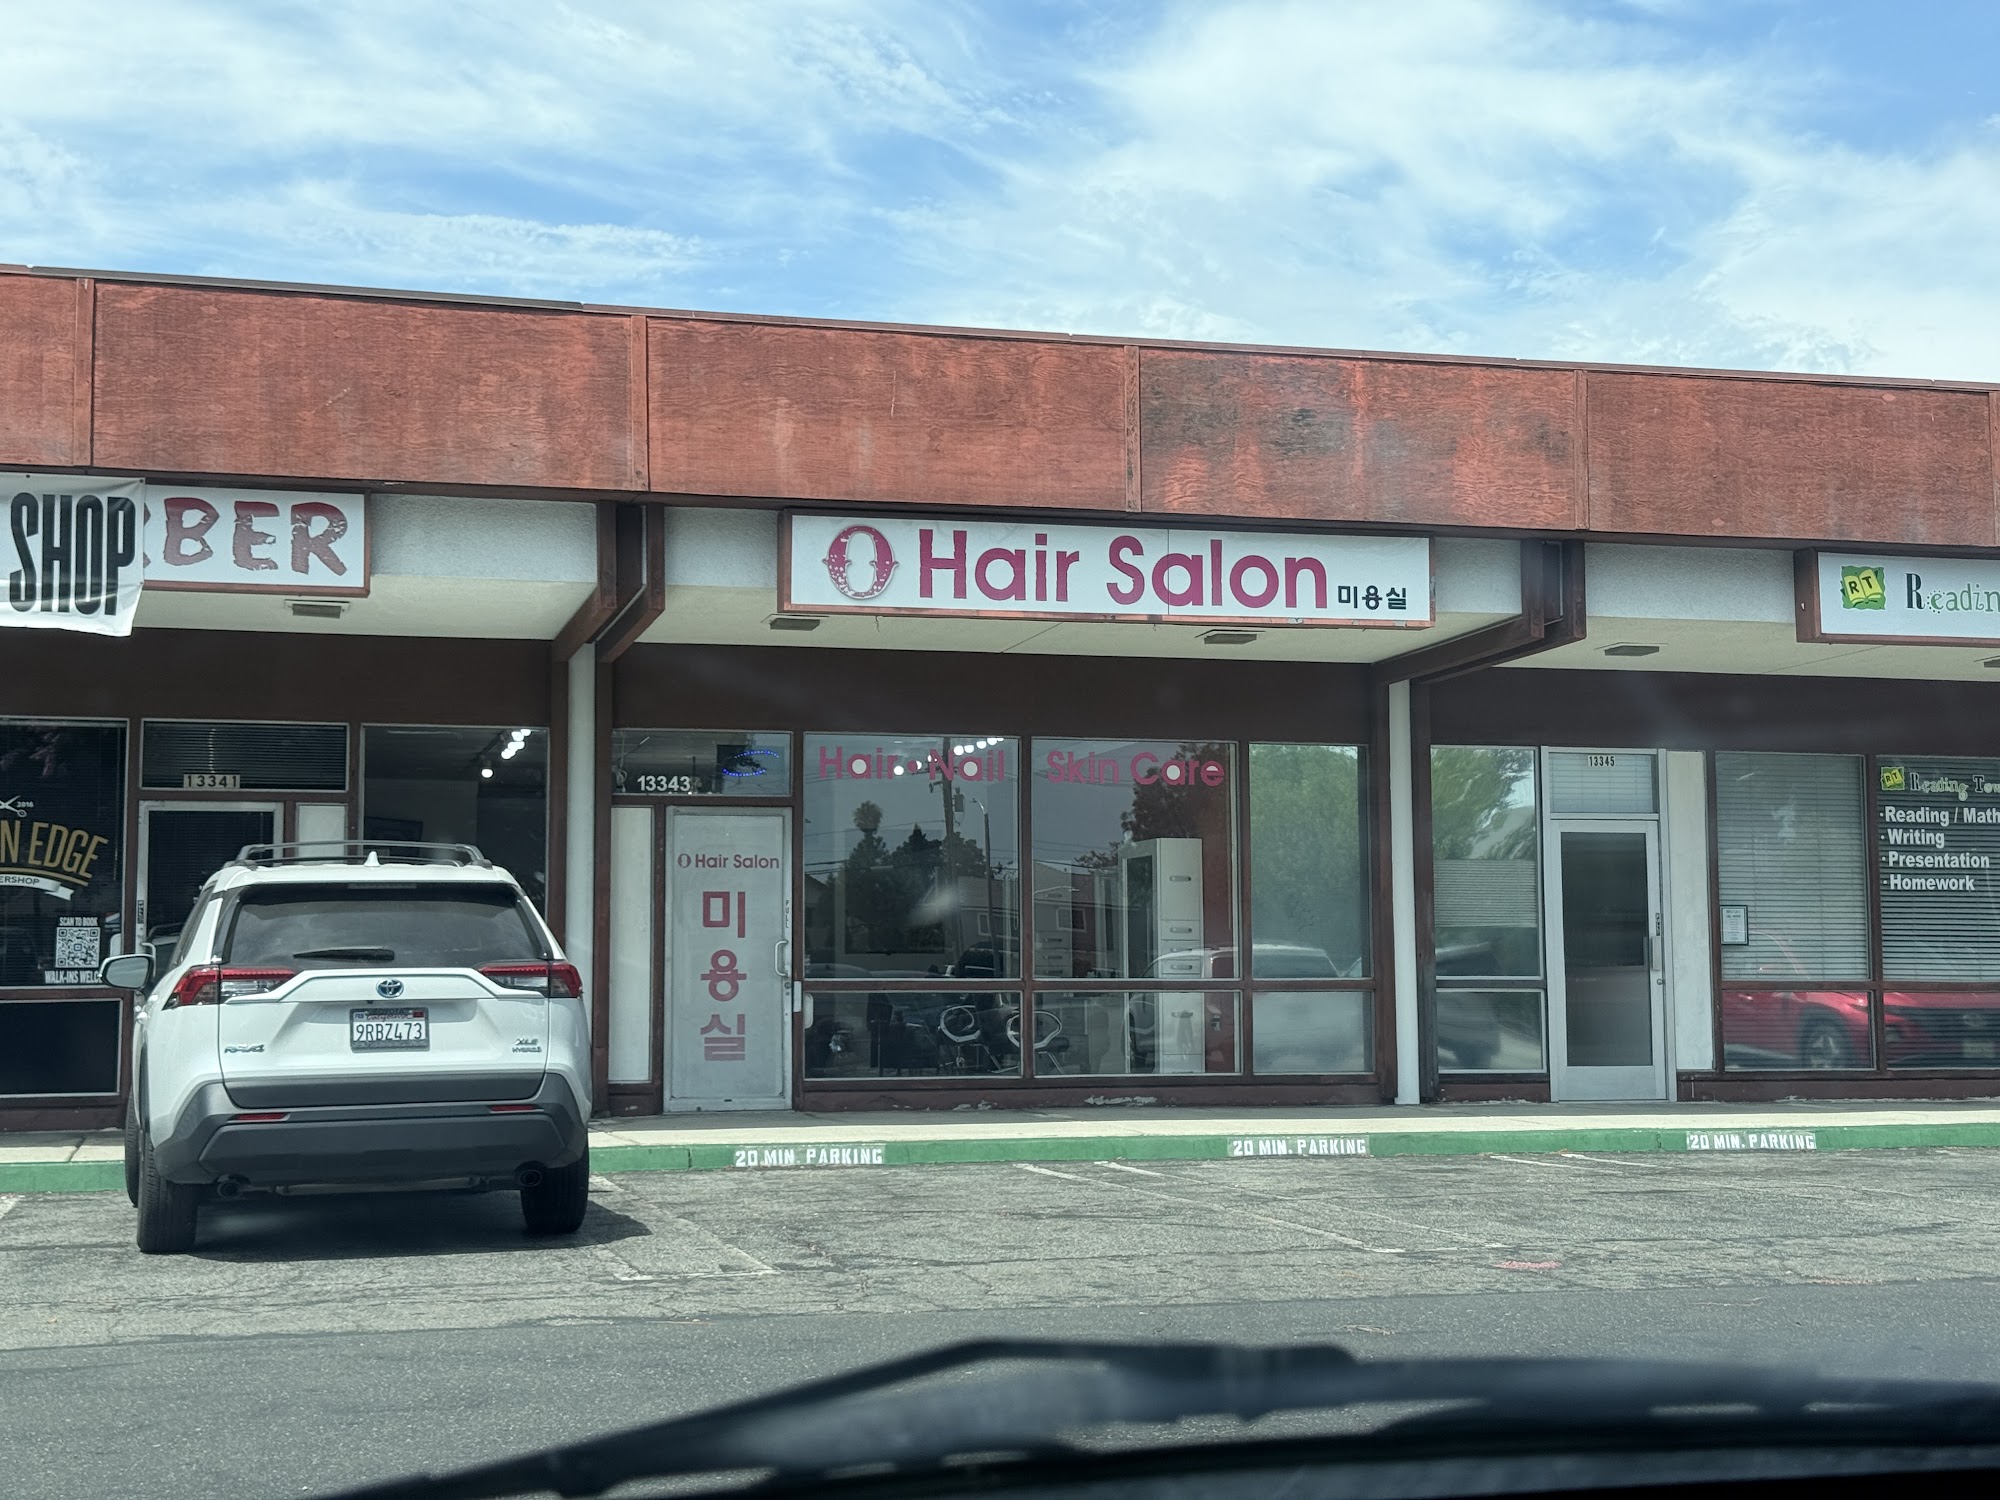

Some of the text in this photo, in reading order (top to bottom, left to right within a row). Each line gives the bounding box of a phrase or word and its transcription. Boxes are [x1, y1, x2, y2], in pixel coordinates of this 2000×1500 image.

[143, 496, 349, 577] BER
[9, 491, 136, 616] SHOP
[821, 524, 1328, 611] O Hair Salon
[1337, 585, 1407, 611] 미용실
[1905, 572, 2000, 615] Readin
[819, 746, 1005, 781] Hair Nail
[1047, 750, 1226, 786] Skin Care
[1588, 755, 1616, 767] 13345
[186, 774, 238, 788] 13341
[637, 775, 691, 792] 13343
[1910, 772, 1969, 801] Reading
[1885, 806, 1949, 827] Reading
[1963, 807, 2000, 823] Math
[1887, 829, 1945, 849] Writing
[28, 821, 109, 879] EDGE
[1888, 851, 1990, 868] Presentation
[695, 853, 729, 868] Hair
[733, 854, 779, 869] Salon
[1890, 874, 1975, 891] Homework
[59, 917, 98, 926] SCAN TO BOOK
[45, 970, 78, 984] WALK-INS
[700, 891, 746, 1061] 미용실
[356, 1023, 422, 1041] 9RBZ473
[1234, 1139, 1366, 1156] 20 MIN. PARKING
[1689, 1133, 1816, 1149] 20 MIN. PARKING
[735, 1150, 758, 1167] 20
[806, 1148, 883, 1164] PARKING
